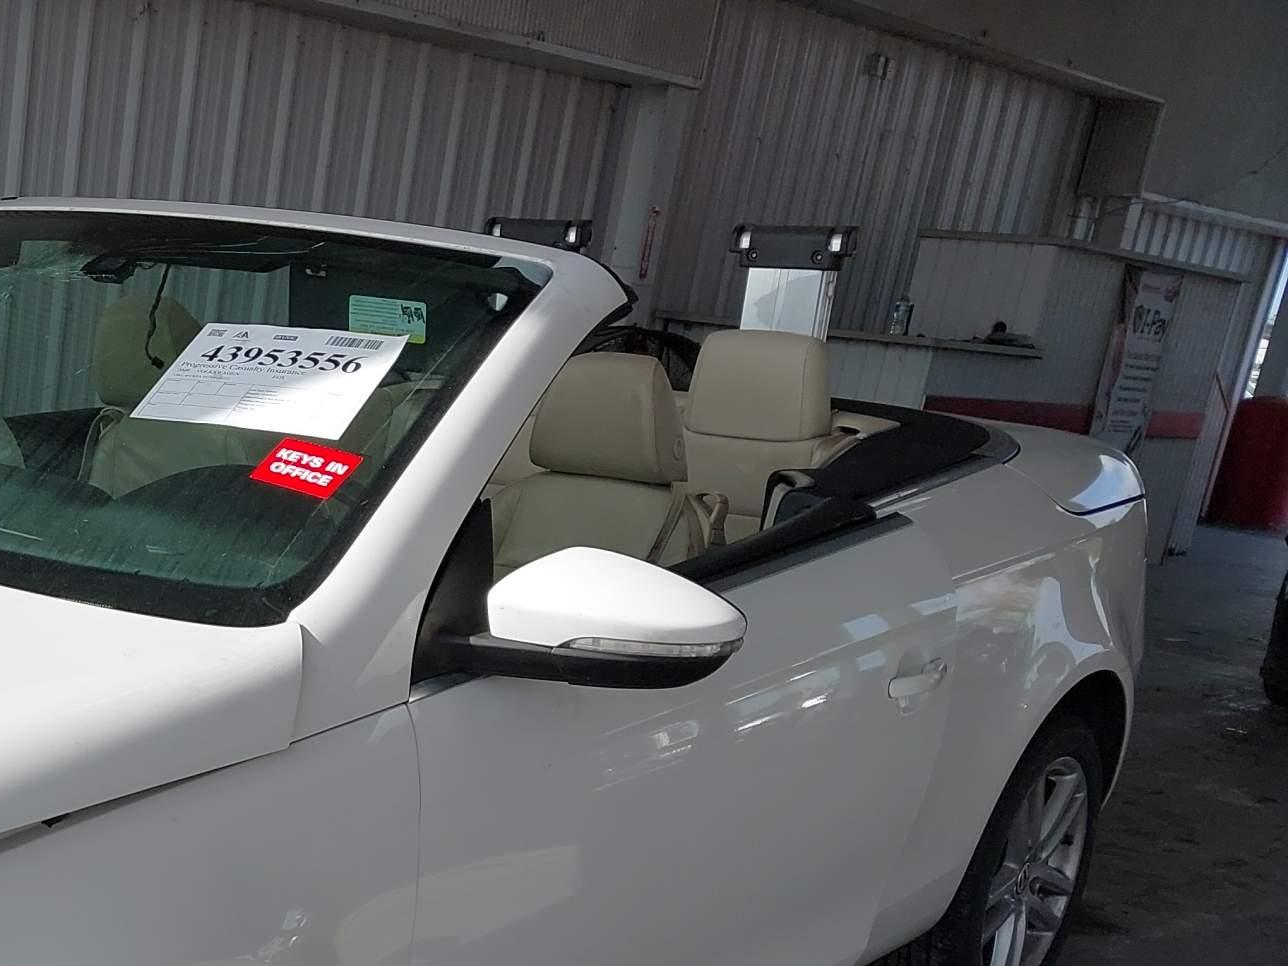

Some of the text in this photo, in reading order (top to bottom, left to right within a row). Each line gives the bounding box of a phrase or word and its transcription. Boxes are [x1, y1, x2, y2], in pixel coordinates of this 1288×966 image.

[181, 361, 307, 376] Progressive Casualty Insurance
[200, 344, 368, 374] 43953556
[269, 461, 334, 487] OFFICE
[275, 448, 350, 475] KEYS IN
